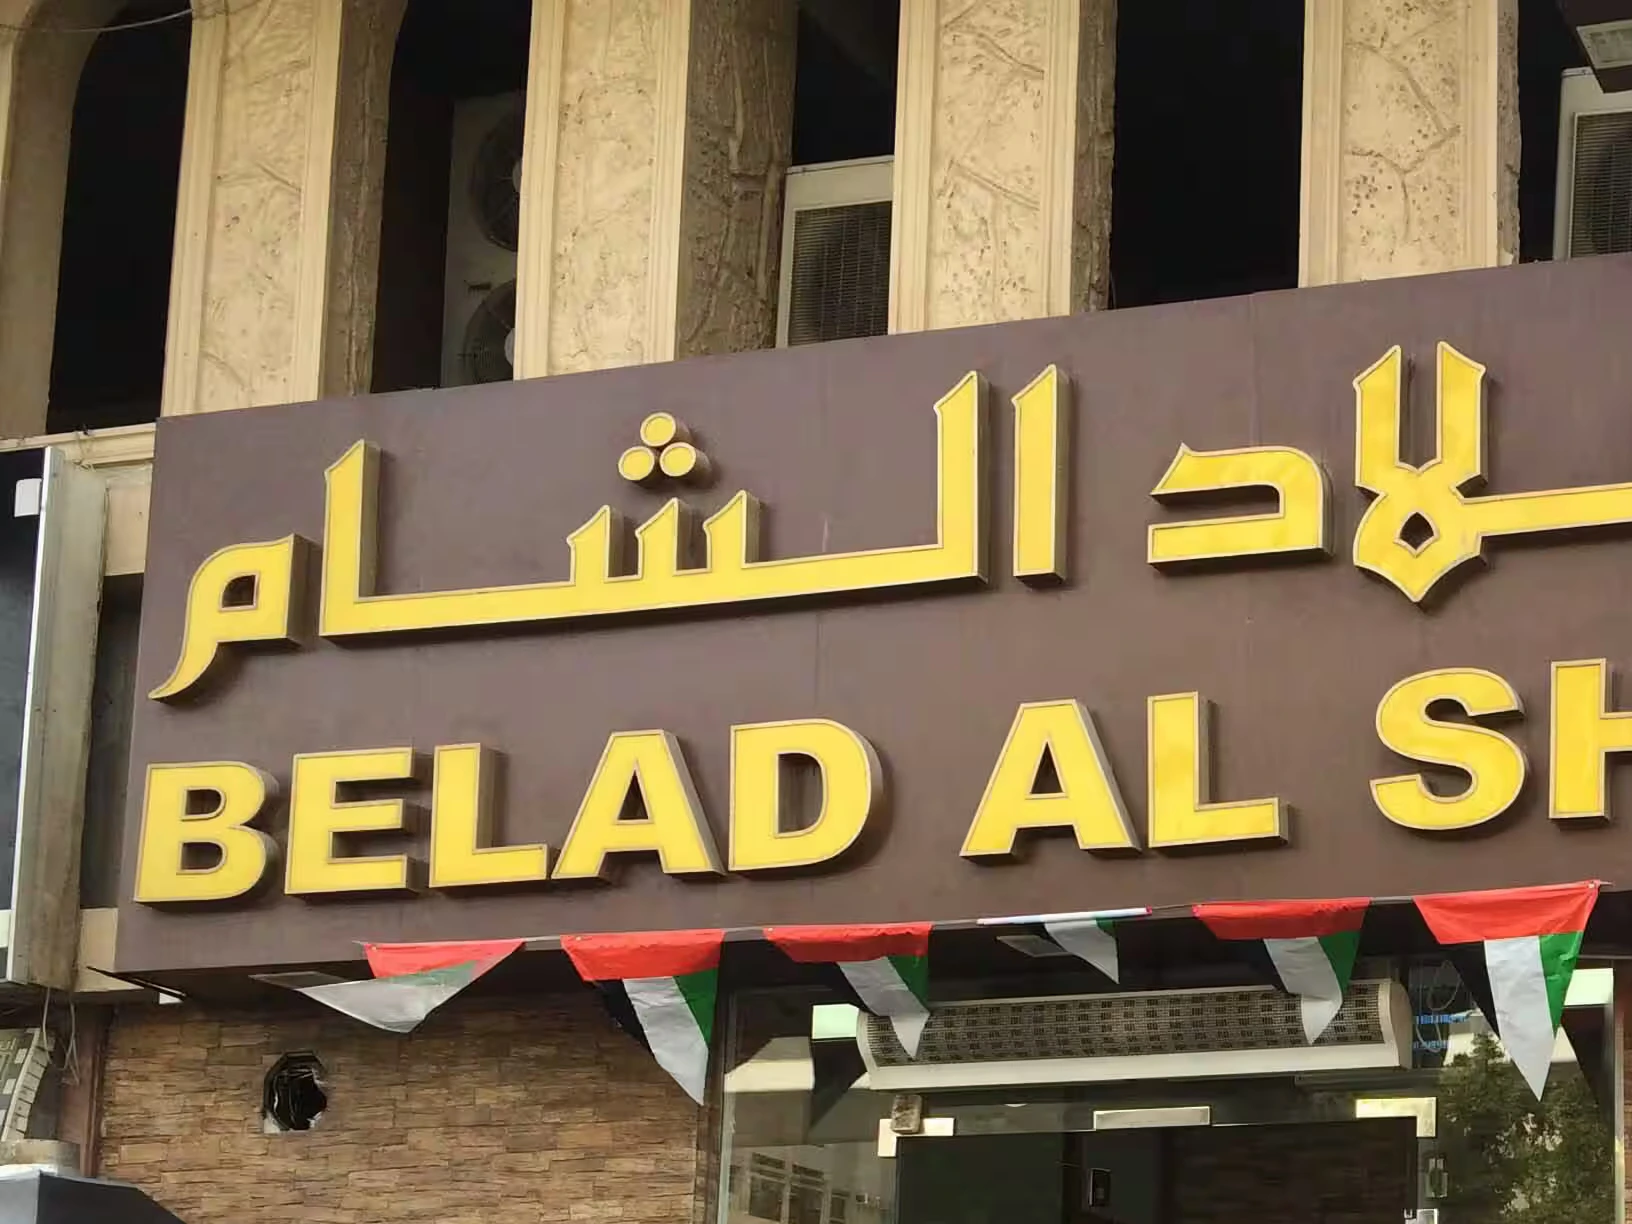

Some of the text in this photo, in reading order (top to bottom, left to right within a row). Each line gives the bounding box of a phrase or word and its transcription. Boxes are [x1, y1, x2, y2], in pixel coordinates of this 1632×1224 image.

[148, 366, 1066, 702] الشام
[133, 717, 882, 904] BELAD
[961, 699, 1284, 860] AL
